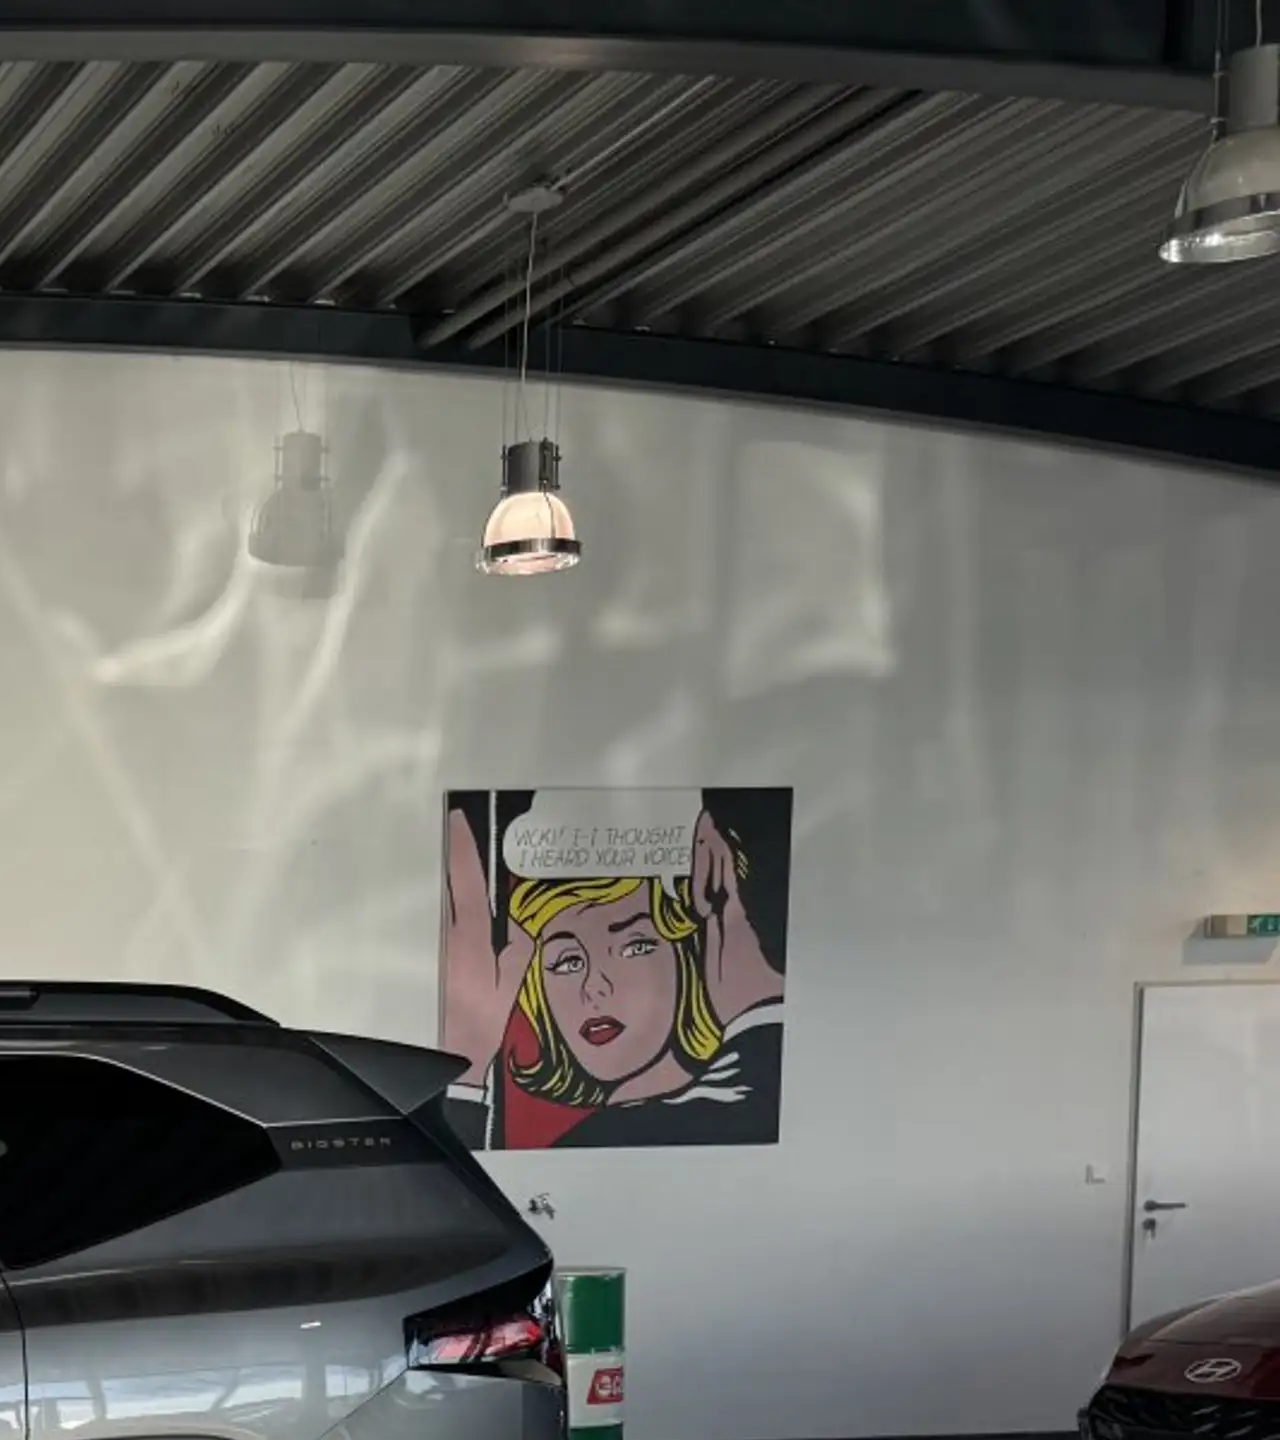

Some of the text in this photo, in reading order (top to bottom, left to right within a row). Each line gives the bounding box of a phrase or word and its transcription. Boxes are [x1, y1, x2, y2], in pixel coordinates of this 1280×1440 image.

[605, 825, 686, 846] THOUGHT
[531, 850, 590, 868] HEARD
[595, 849, 636, 867] YOUR
